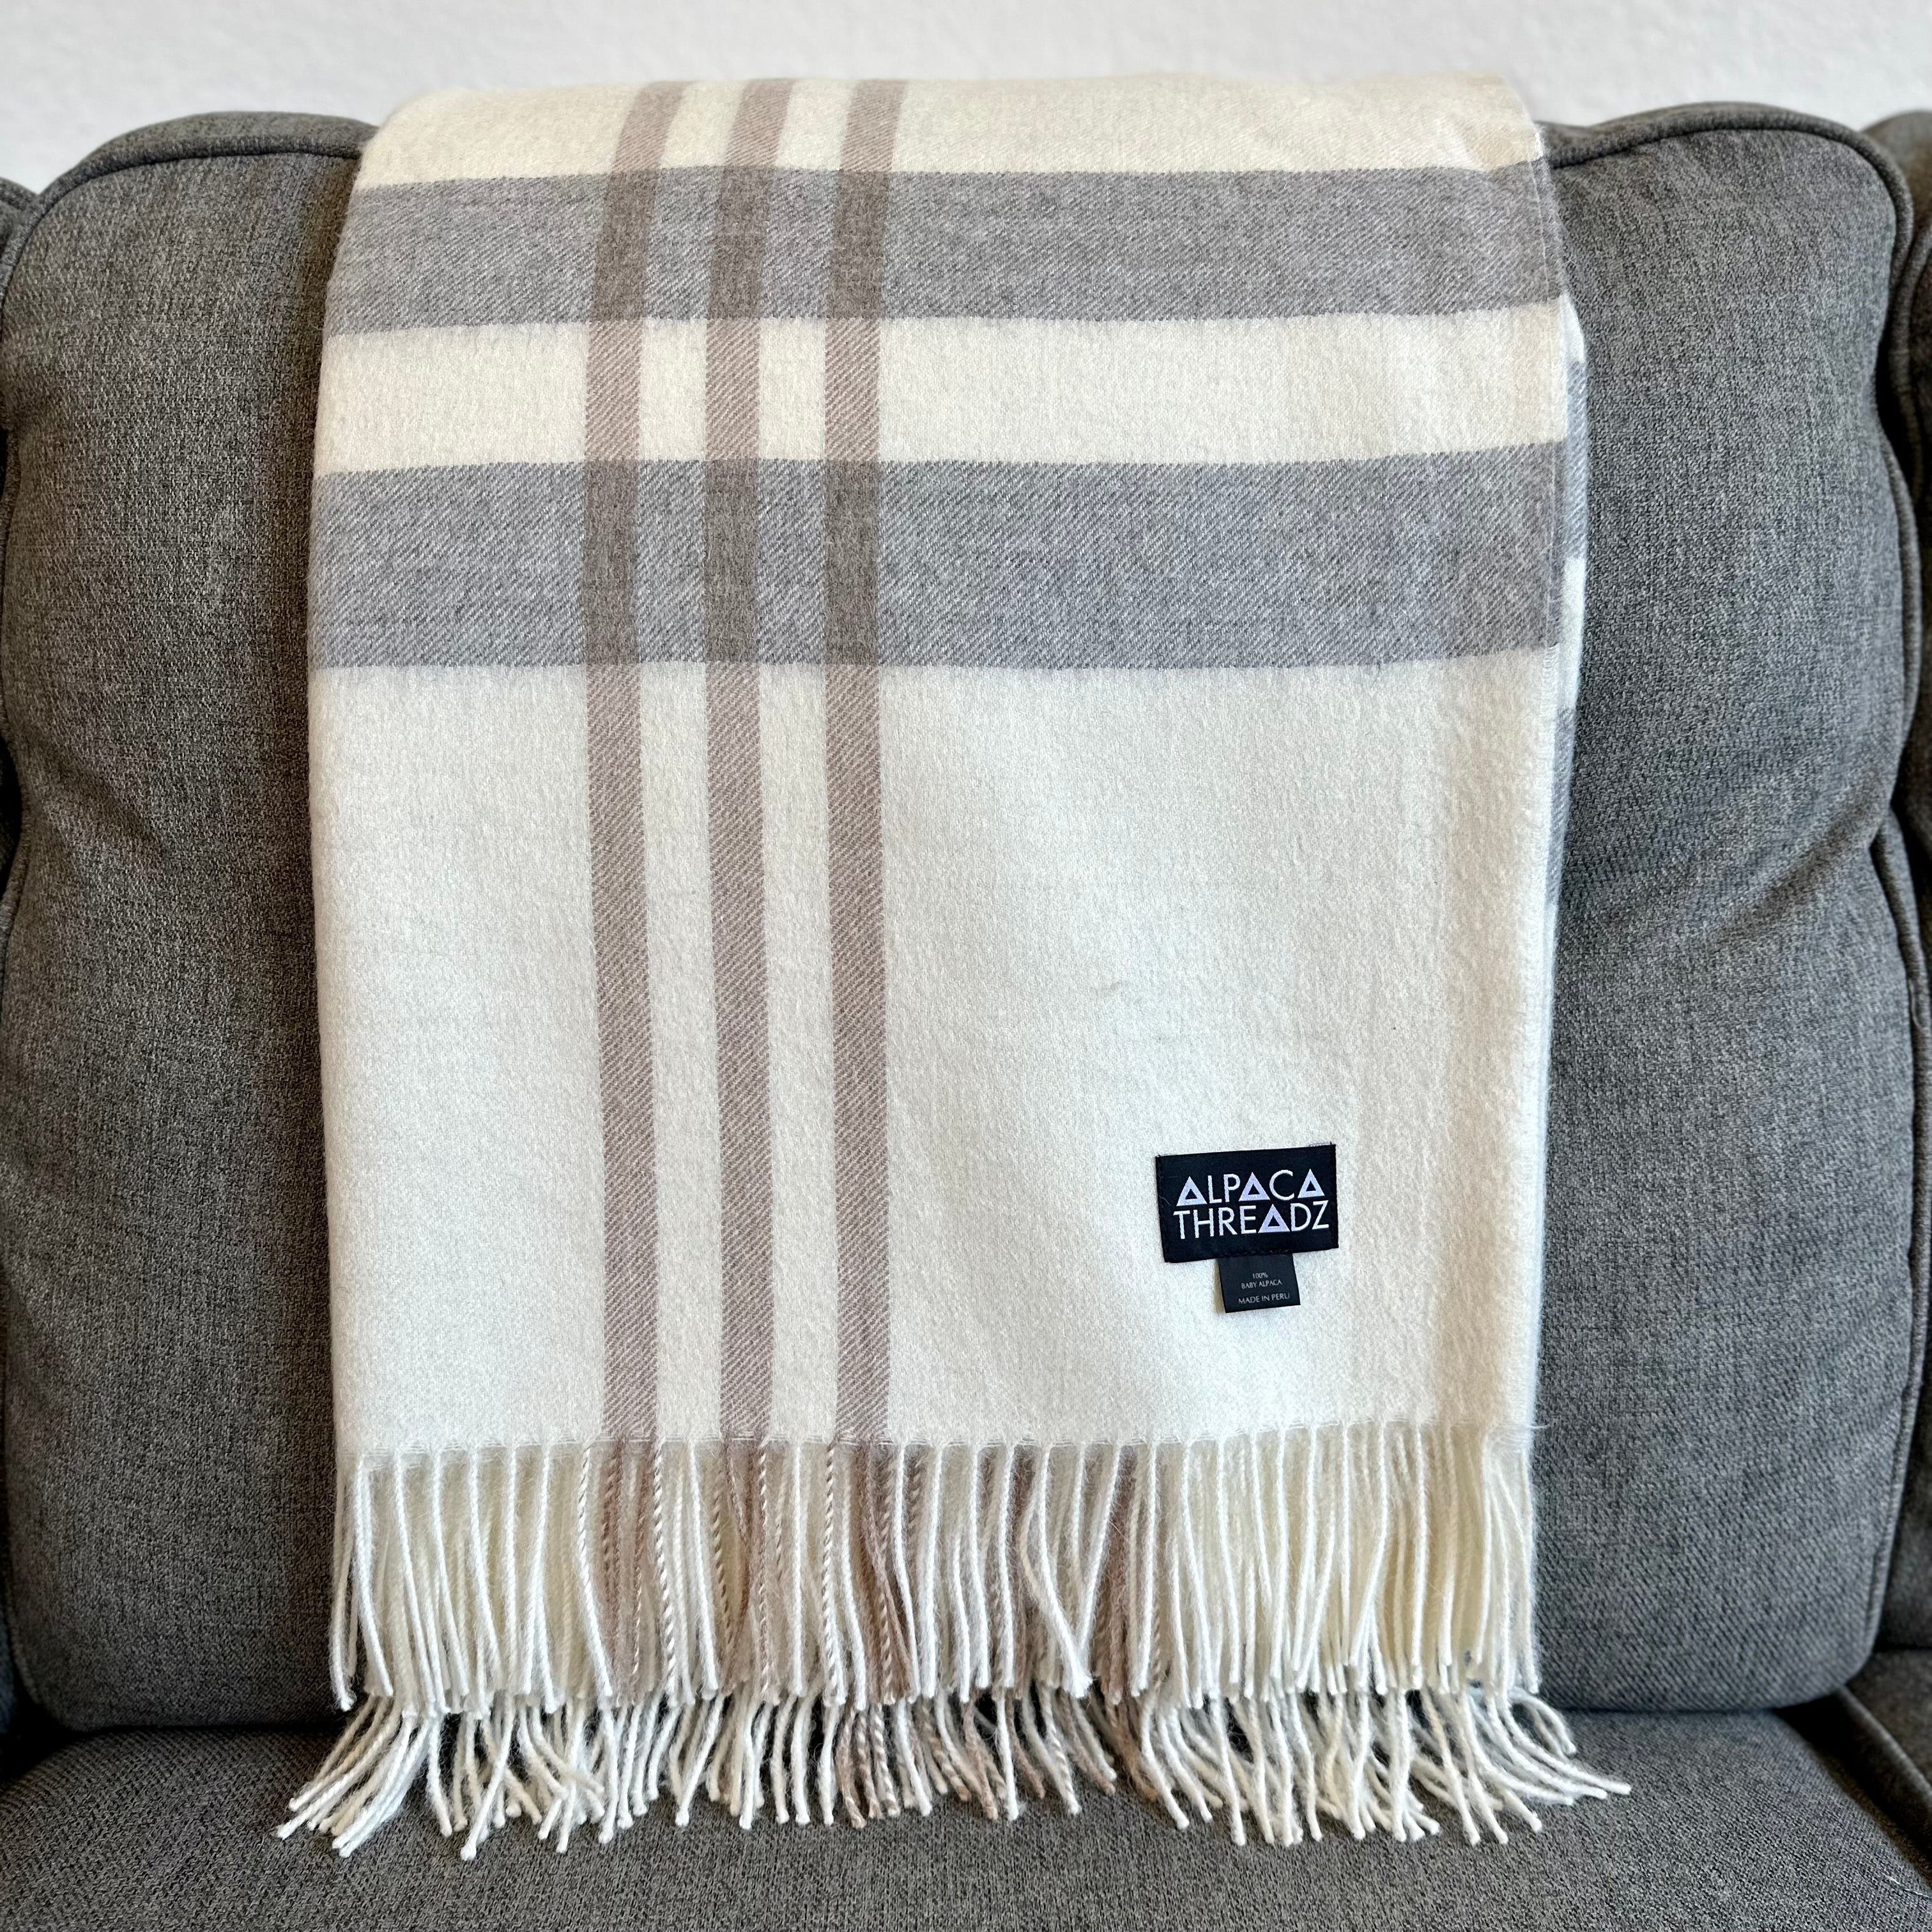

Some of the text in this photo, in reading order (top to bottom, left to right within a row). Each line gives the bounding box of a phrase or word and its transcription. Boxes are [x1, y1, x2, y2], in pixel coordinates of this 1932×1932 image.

[1176, 1169, 1325, 1206] ALPACA
[1173, 1200, 1330, 1239] THREADZ
[1241, 1279, 1283, 1289] BABY ALPACA
[1238, 1296, 1261, 1304] MADE
[1271, 1292, 1290, 1301] PERU
